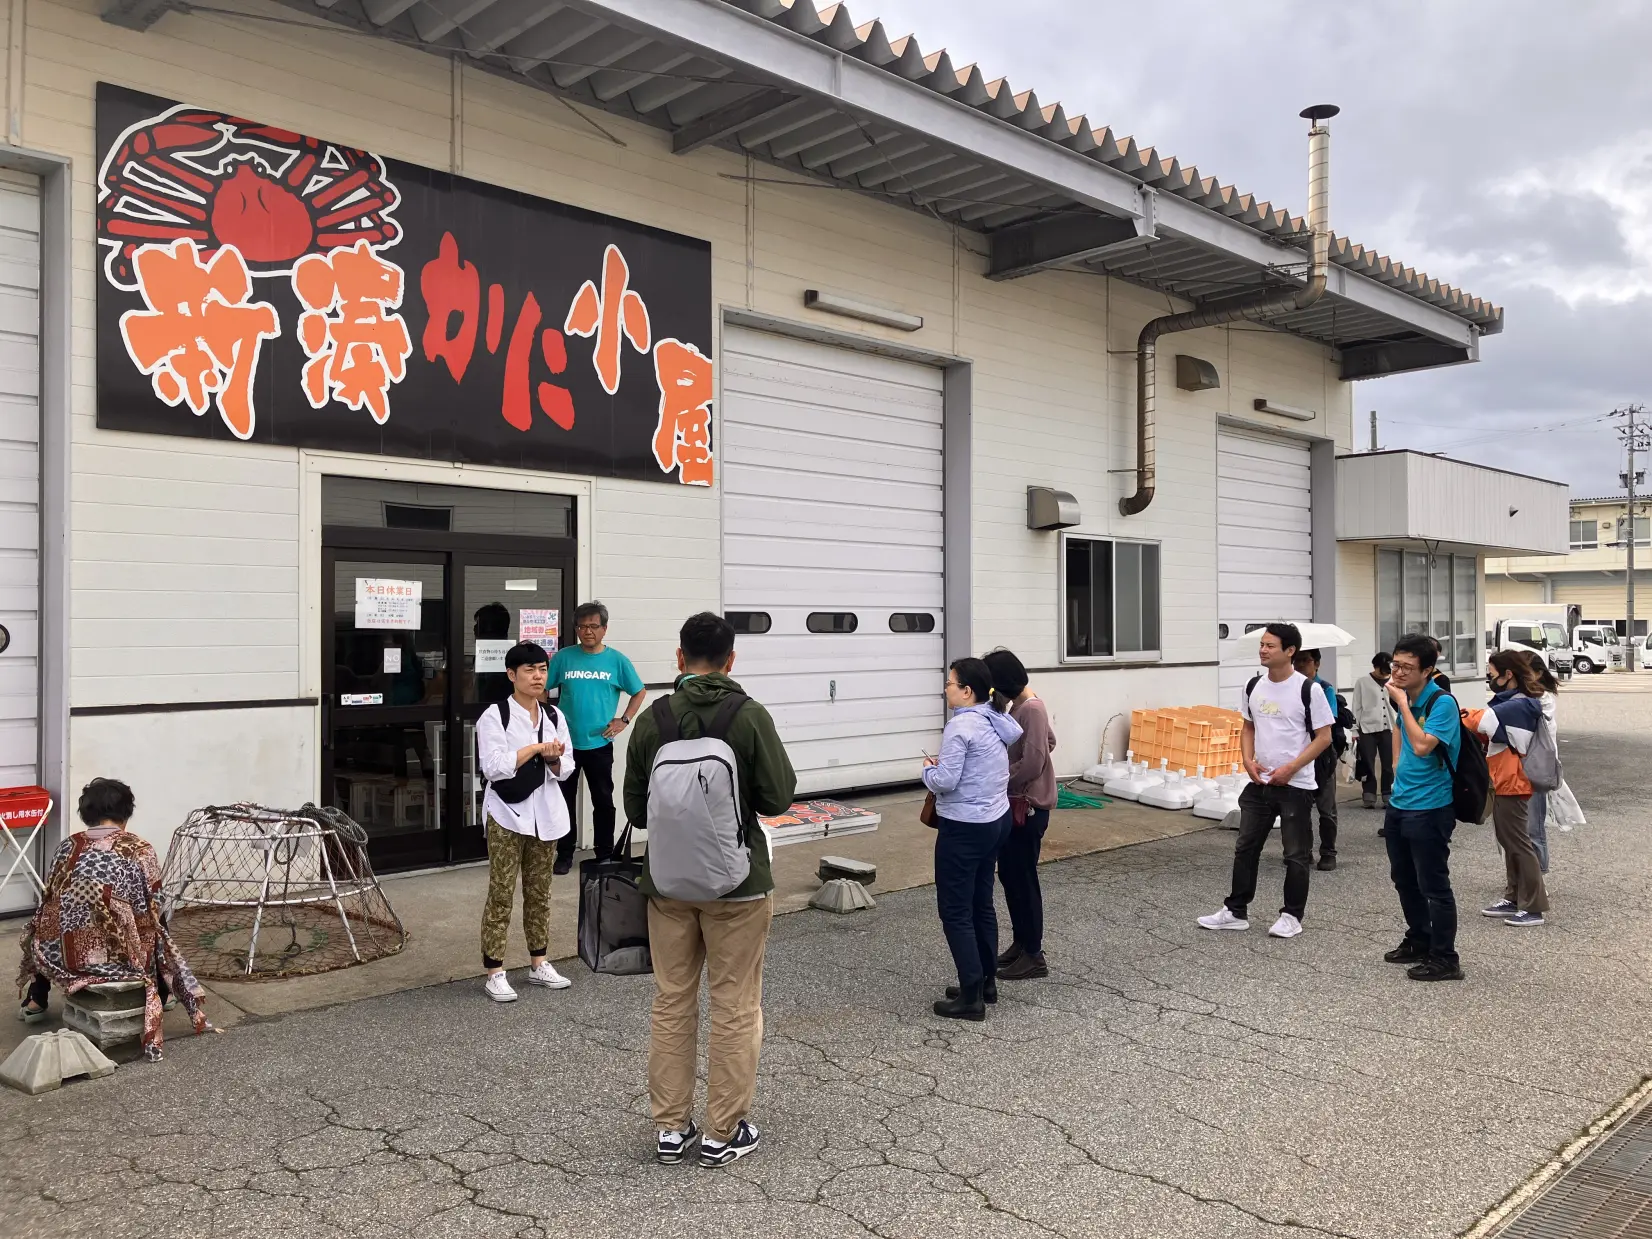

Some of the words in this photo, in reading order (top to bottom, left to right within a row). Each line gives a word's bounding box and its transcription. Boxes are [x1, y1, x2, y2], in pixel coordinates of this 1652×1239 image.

[118, 231, 713, 487] 新湊かに小屋
[365, 585, 412, 596] 本日休業日
[564, 670, 612, 681] HUNGARY
